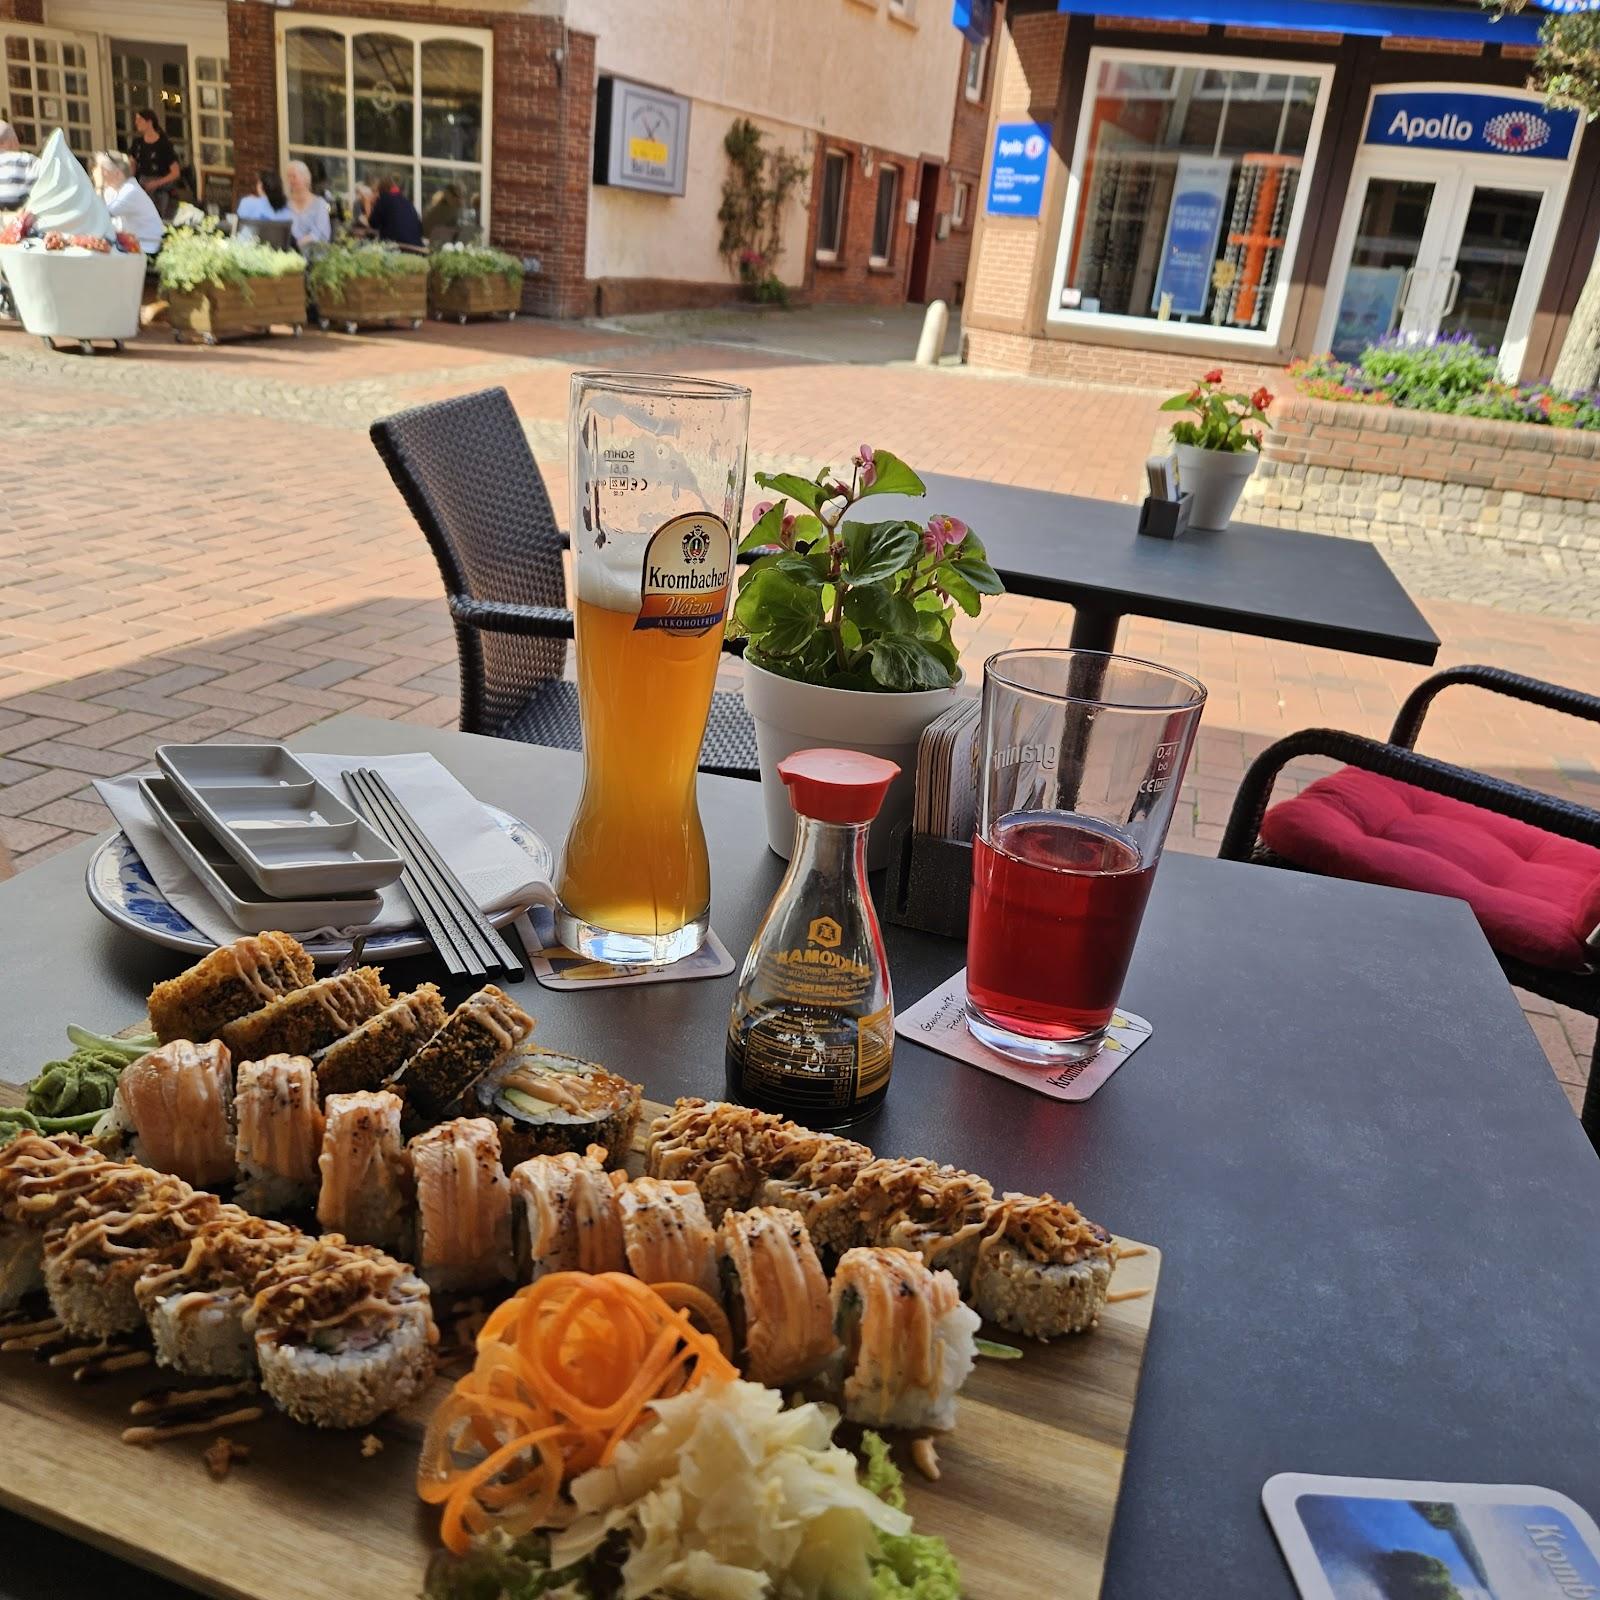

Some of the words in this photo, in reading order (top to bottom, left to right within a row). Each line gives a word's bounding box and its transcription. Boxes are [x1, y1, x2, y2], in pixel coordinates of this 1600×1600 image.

[1387, 109, 1474, 143] Apollo
[648, 565, 728, 590] Krombacher
[665, 596, 713, 616] Weizen
[657, 616, 717, 627] ALKOHOLFREI
